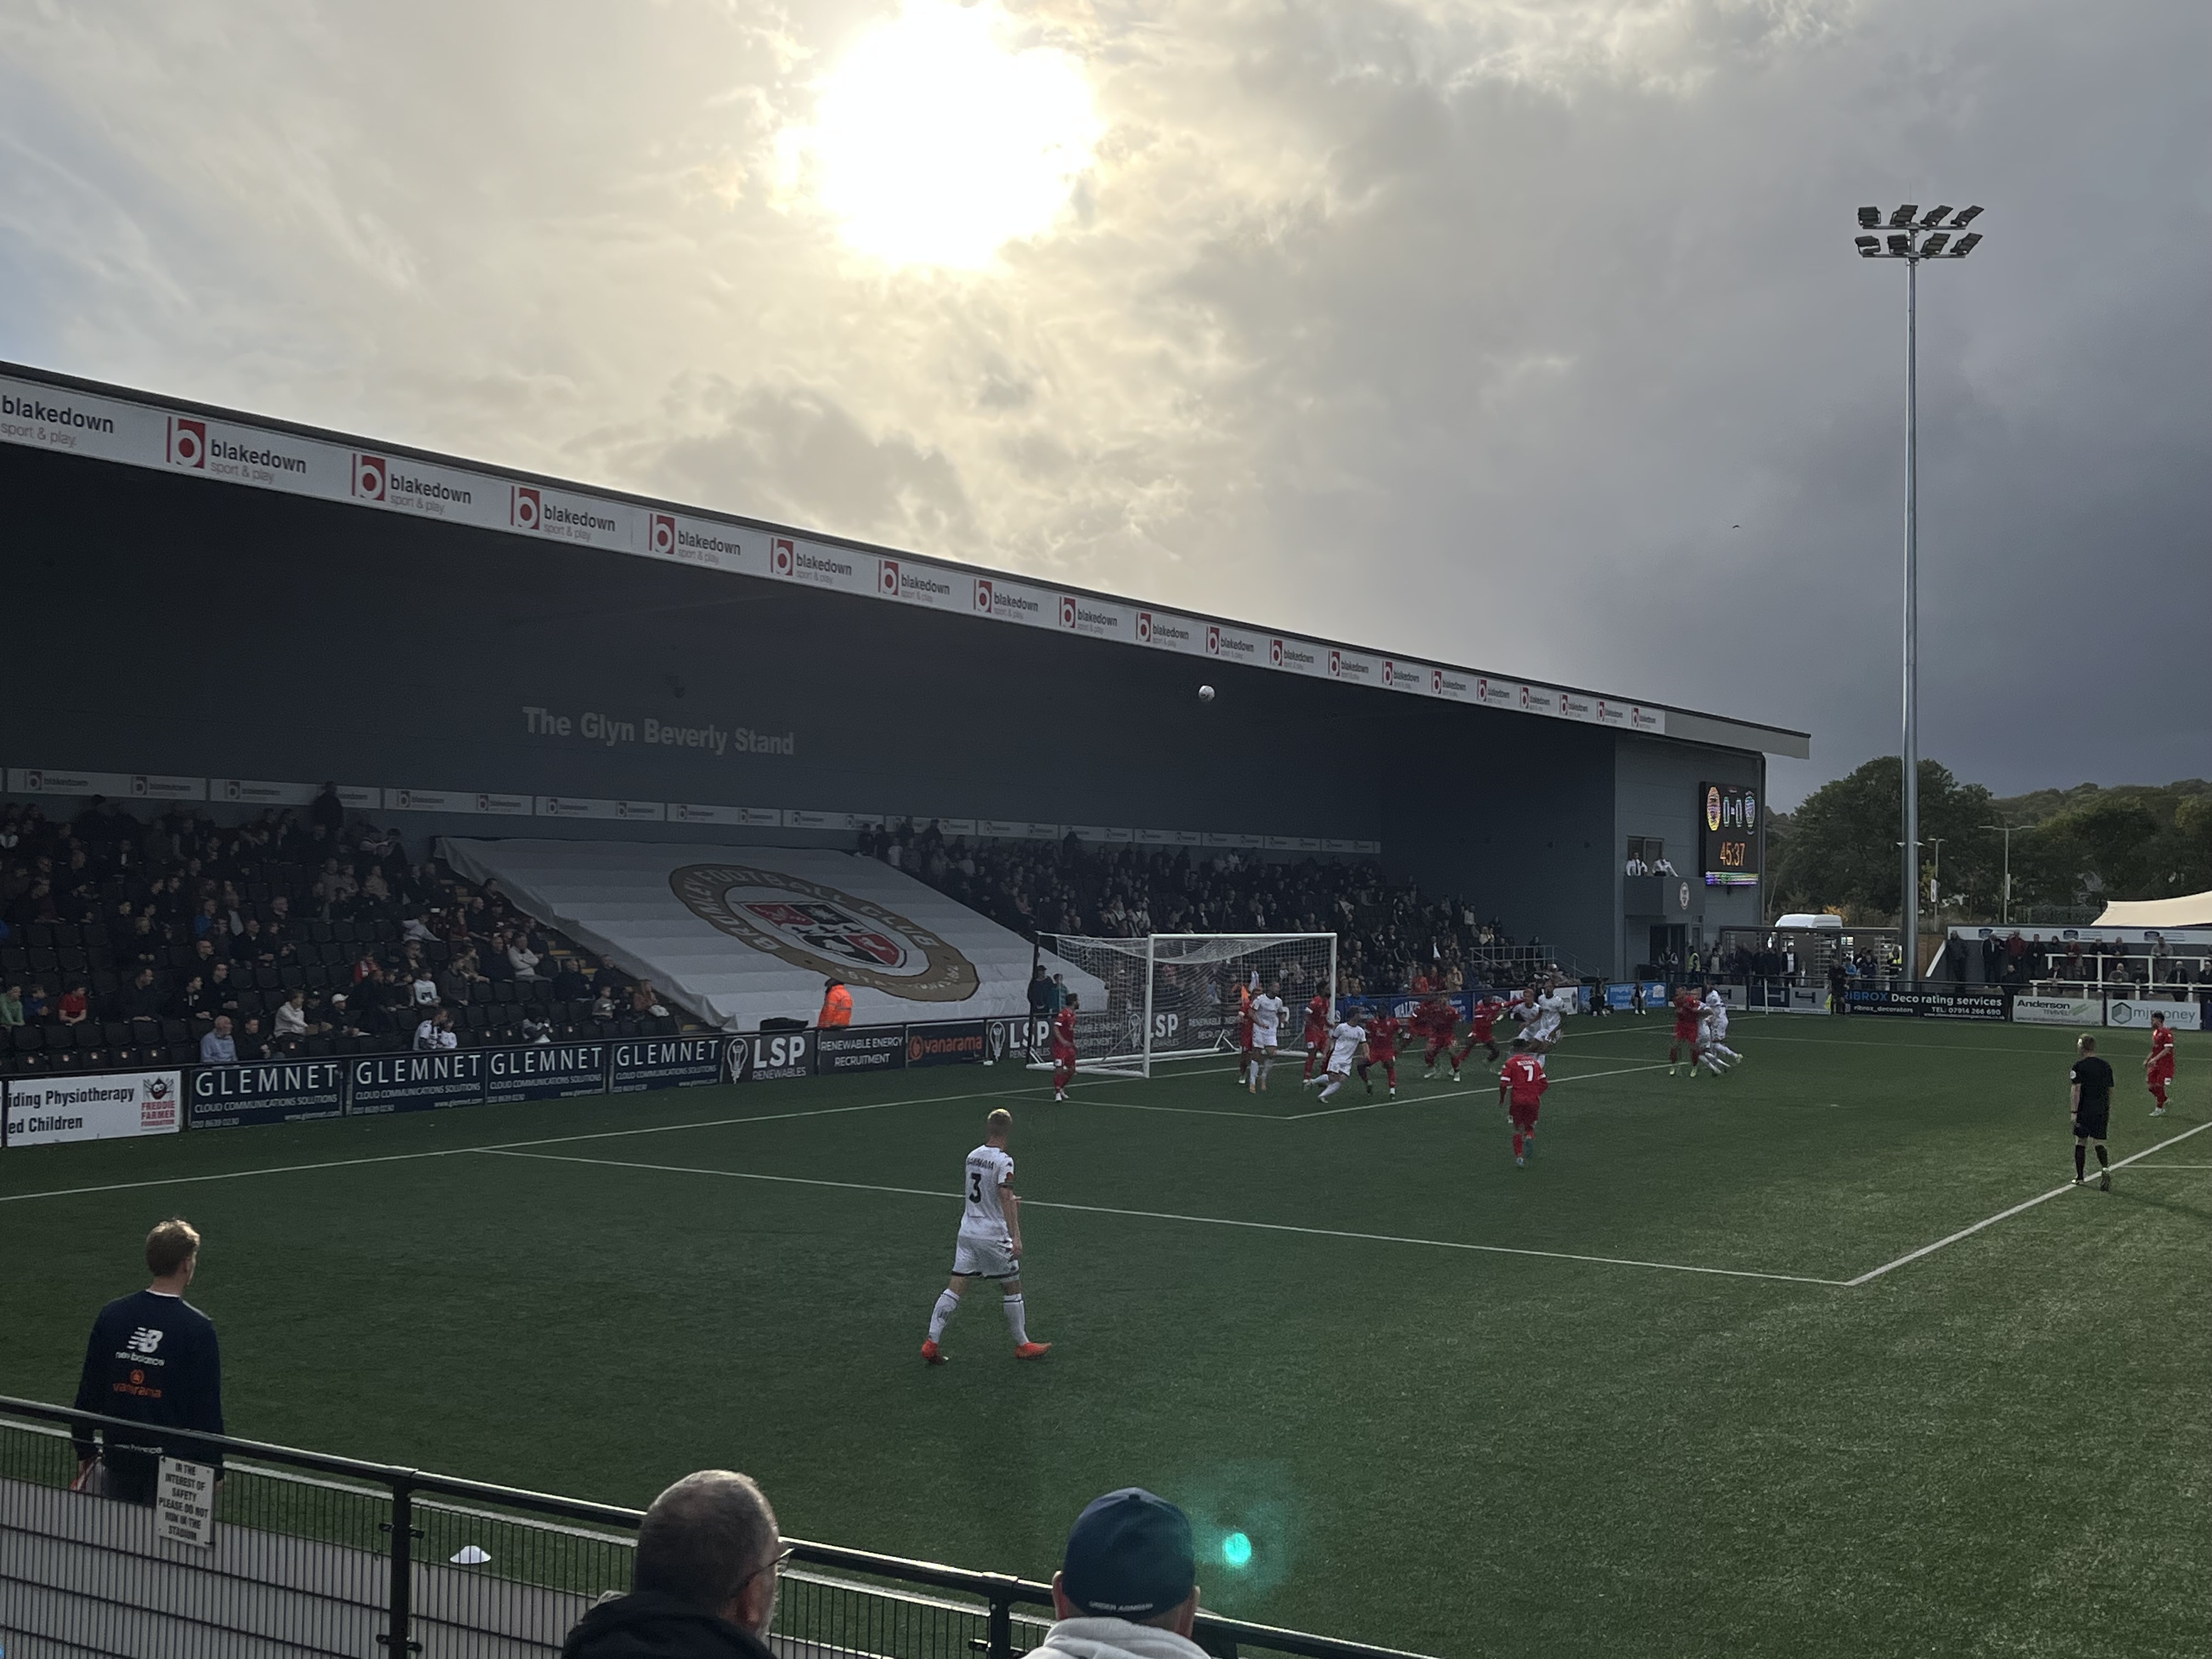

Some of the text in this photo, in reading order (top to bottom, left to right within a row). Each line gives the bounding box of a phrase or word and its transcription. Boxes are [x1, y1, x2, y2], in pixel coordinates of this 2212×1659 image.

[2, 396, 113, 433] blakedown
[1, 422, 33, 439] sport
[38, 428, 47, 440] &
[211, 439, 307, 473] blakedown
[211, 462, 239, 476] sport
[391, 474, 471, 504] blakedown
[544, 504, 616, 532] blakedown
[678, 530, 741, 556] blakedown
[797, 553, 852, 577] blakedown
[901, 574, 950, 595] blakedown
[994, 592, 1039, 612] blakedown
[1077, 609, 1118, 627] blakedown
[522, 706, 794, 755] The Glyn Beverly Stand
[860, 906, 940, 946] CLUB
[1892, 994, 1919, 1002] Deco
[1921, 994, 1954, 1006] rating
[1957, 996, 2002, 1006] services
[2017, 1000, 2070, 1009] Anderson
[1150, 1014, 1178, 1038] SP
[2134, 1009, 2196, 1023] mjroney
[821, 1036, 904, 1051] RENEWABLE ENERGY
[924, 1036, 982, 1053] vanarama
[1009, 1021, 1049, 1048] LSP
[490, 1047, 602, 1075] GLEMNET
[616, 1040, 719, 1066] GLEMNET
[753, 1036, 805, 1069] LSP
[834, 1053, 890, 1066] RECRUITMENT
[357, 1054, 481, 1085] GLEMNET
[752, 1066, 806, 1080] RENEWABLES
[1523, 1065, 1534, 1081] 7
[195, 1064, 337, 1097] GLEMNET
[46, 1087, 134, 1107] Physiotherapy
[142, 1101, 175, 1110] FREDDIE
[142, 1110, 175, 1120] FARMER
[195, 1103, 222, 1114] CLOUD
[8, 1116, 82, 1133] ed Children
[969, 1172, 981, 1203] 3
[184, 1465, 196, 1476] THE
[166, 1473, 205, 1491] INTEREST OF
[172, 1488, 196, 1502] SAFETY
[159, 1497, 208, 1518] PLEASE DO NOT
[189, 1517, 201, 1529] THE
